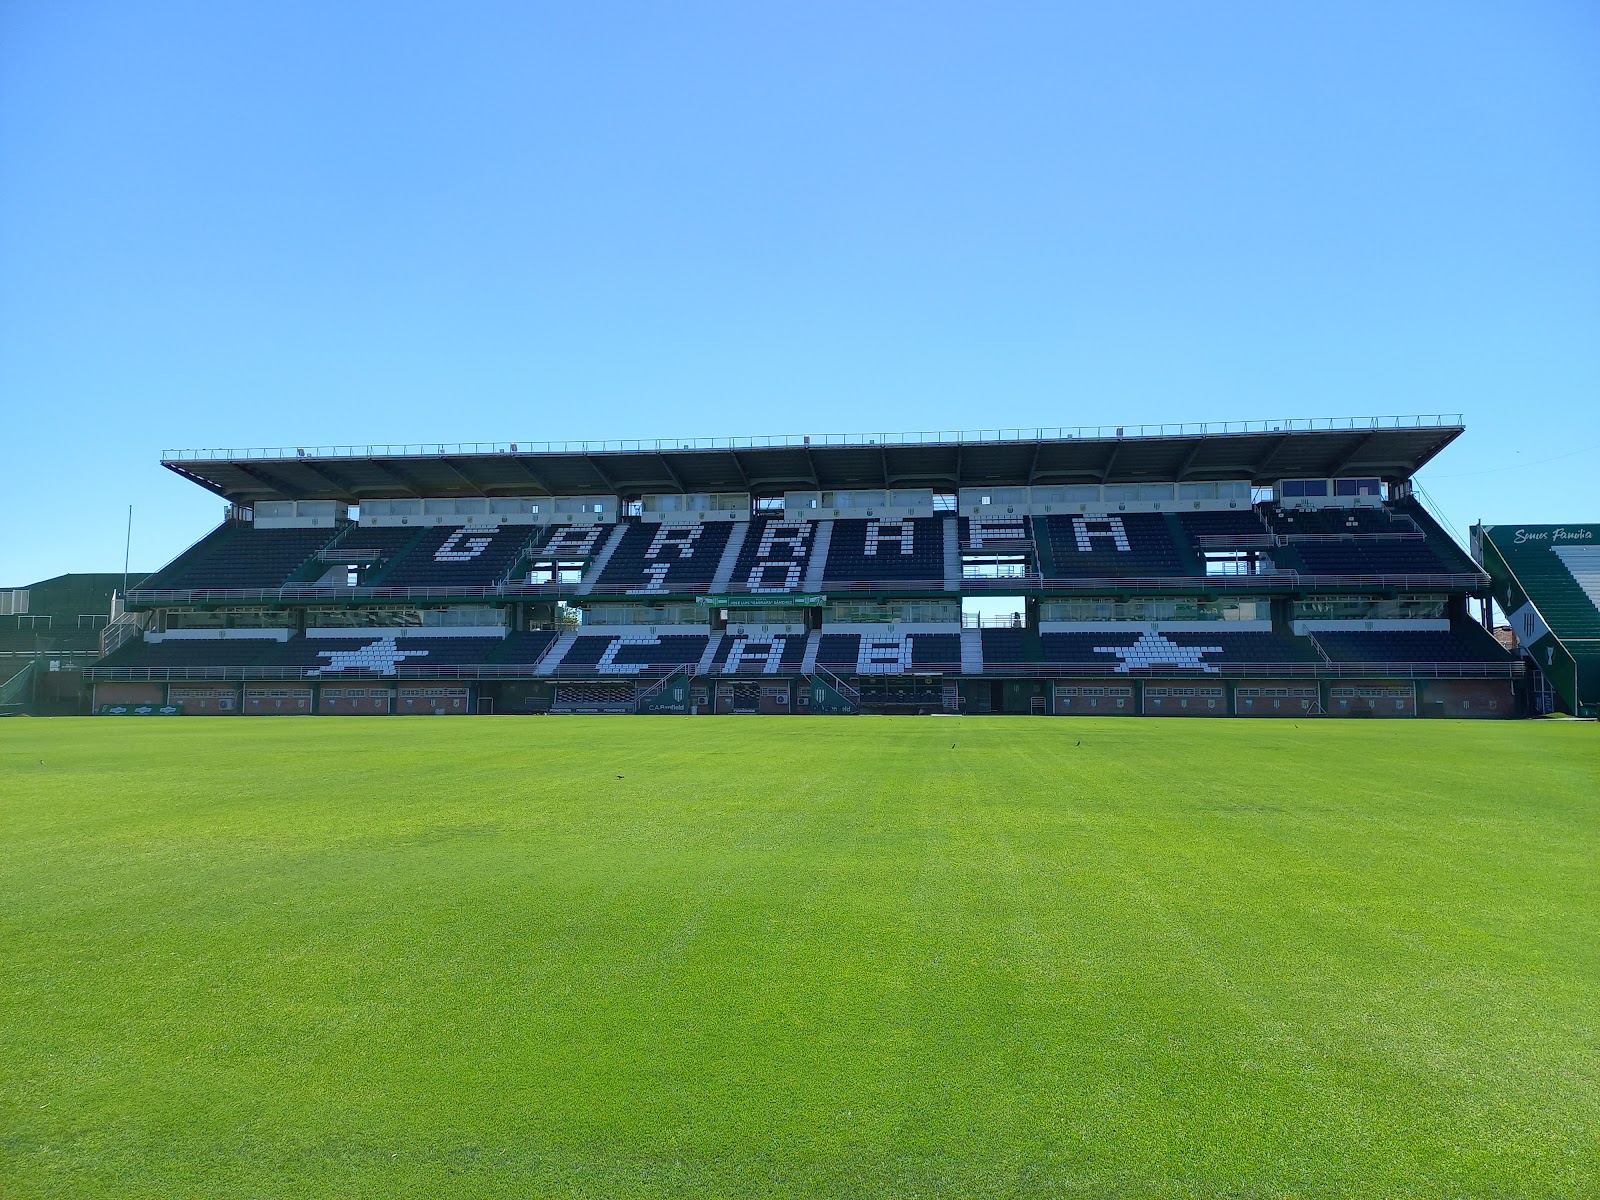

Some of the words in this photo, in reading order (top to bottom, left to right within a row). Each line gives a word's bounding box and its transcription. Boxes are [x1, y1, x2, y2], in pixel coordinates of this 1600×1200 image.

[434, 513, 1132, 562] GARRAFA
[1513, 529, 1548, 544] Somos
[1552, 528, 1592, 542] Familia
[595, 633, 913, 674] CAB
